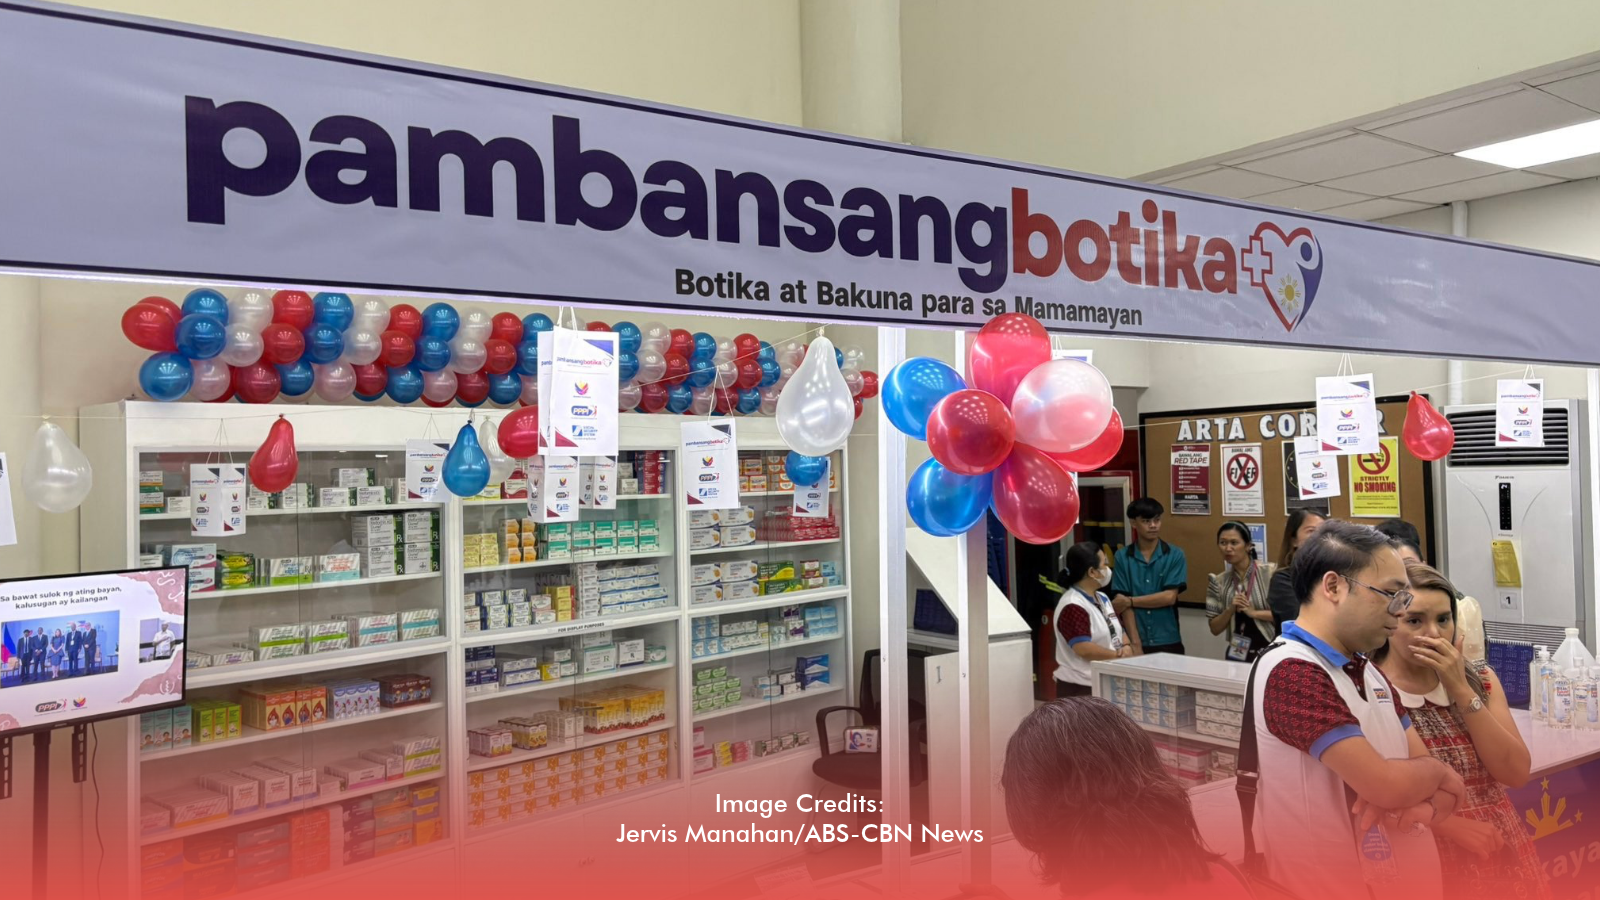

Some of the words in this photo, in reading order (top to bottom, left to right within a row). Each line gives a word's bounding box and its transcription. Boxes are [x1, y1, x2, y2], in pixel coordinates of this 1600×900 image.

[675, 268, 770, 301] Botika
[780, 280, 807, 304] at
[817, 281, 913, 311] Bakuna
[921, 293, 974, 318] para
[982, 297, 1007, 316] sa
[1015, 296, 1143, 329] Mamamayan
[1177, 417, 1245, 442] ARTA
[1259, 409, 1387, 440] CORR
[1354, 482, 1363, 492] NO
[1364, 482, 1396, 492] SMOKING
[12, 593, 37, 601] bawat
[39, 590, 61, 598] sulok
[75, 588, 96, 596] ating
[97, 586, 122, 594] bayan,
[1505, 596, 1512, 605] 1
[15, 600, 57, 609] kalusugan
[70, 595, 108, 604] kailangan
